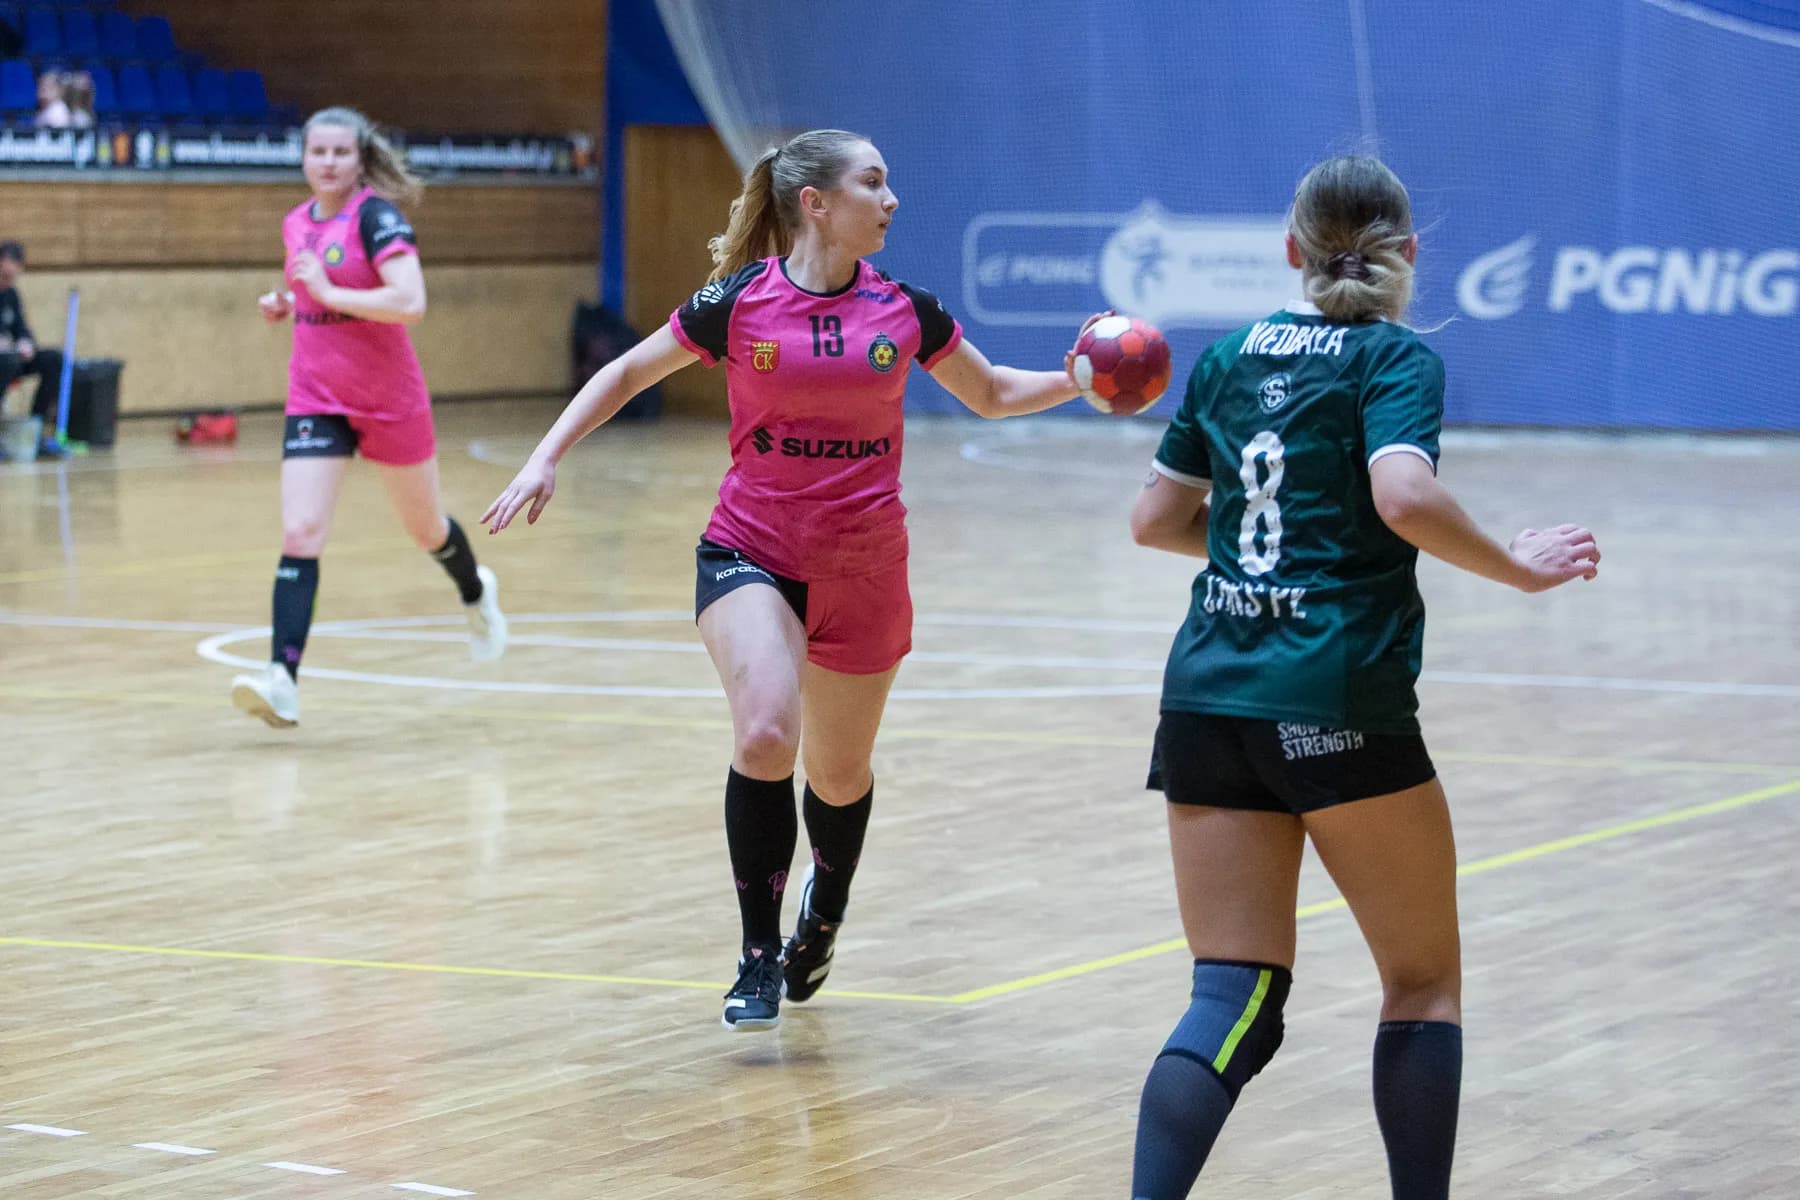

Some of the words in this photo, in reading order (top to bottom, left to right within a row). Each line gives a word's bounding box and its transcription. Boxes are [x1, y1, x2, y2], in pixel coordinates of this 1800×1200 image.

[1550, 246, 1800, 313] PGNiG
[808, 315, 845, 358] 13
[753, 353, 774, 370] CK
[781, 437, 891, 459] SUZUKI
[1238, 430, 1286, 577] 8
[1282, 729, 1364, 760] STRENGTH
